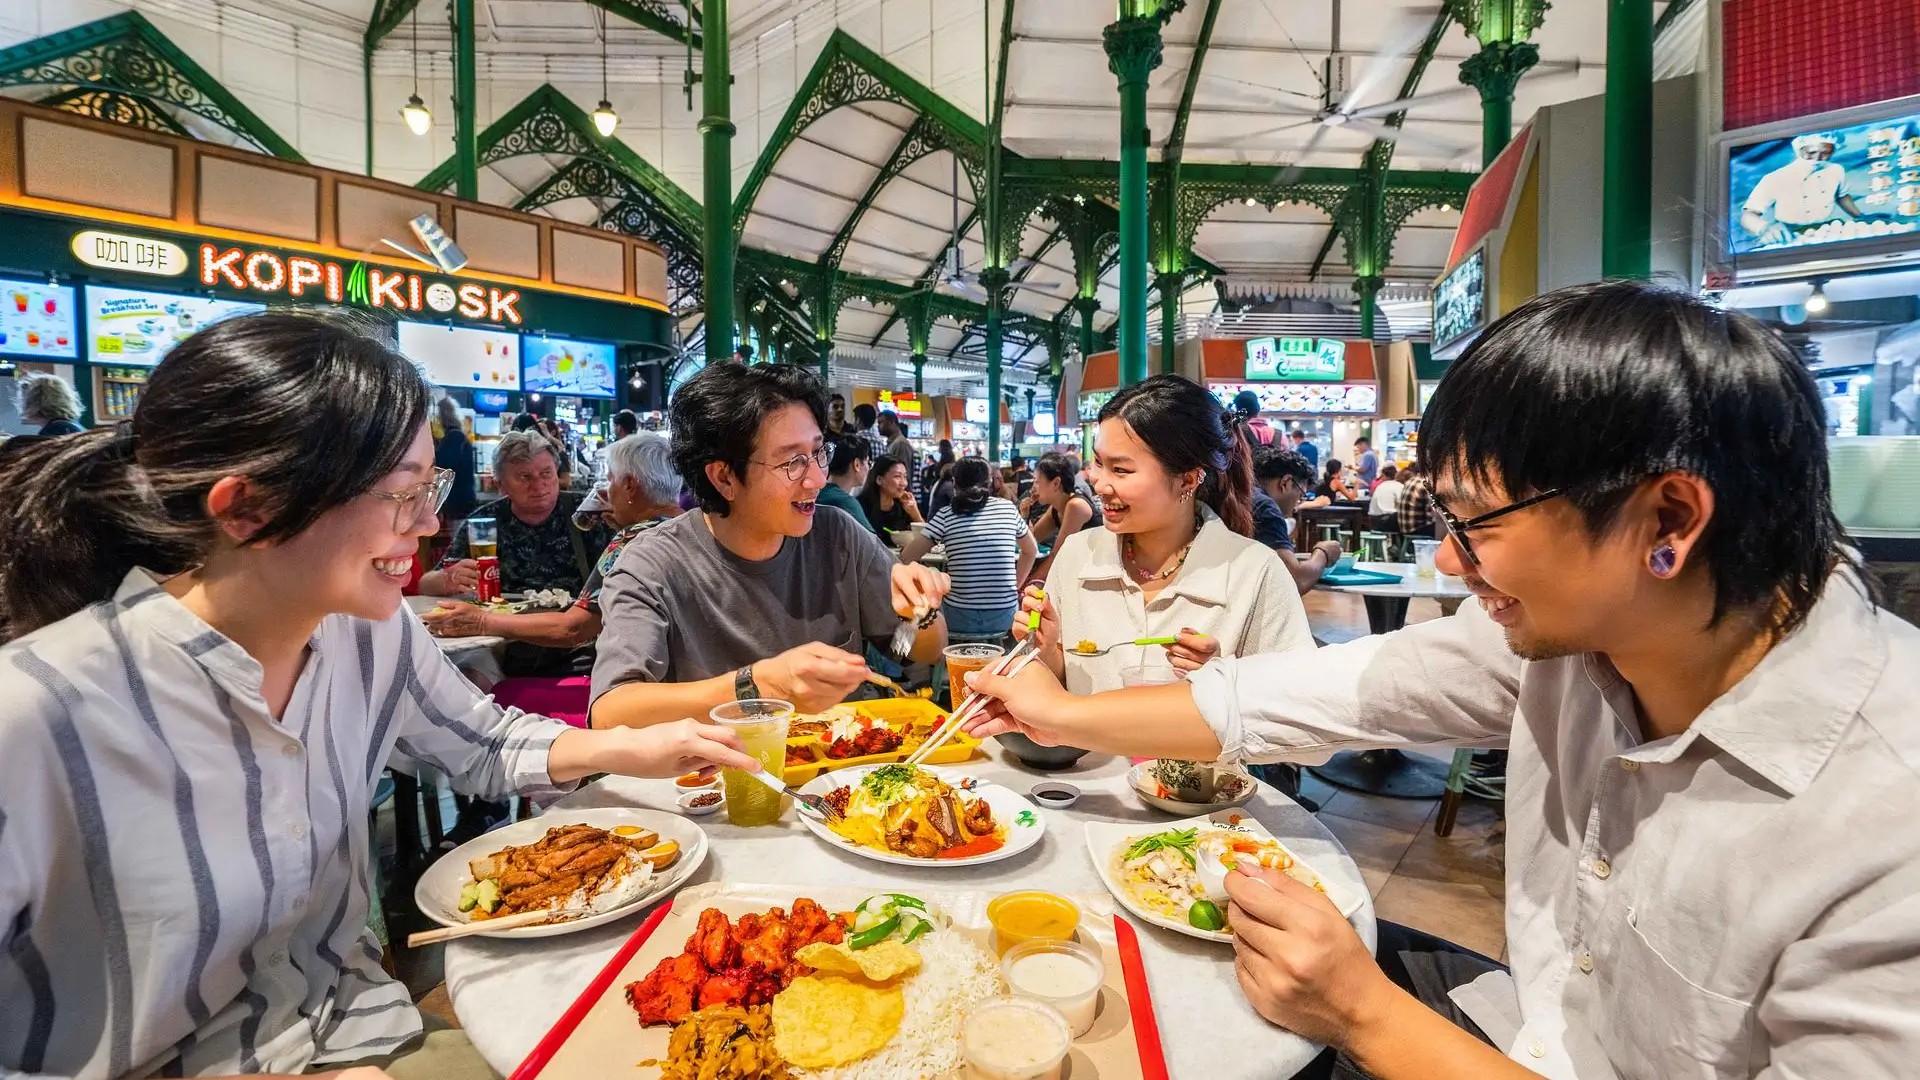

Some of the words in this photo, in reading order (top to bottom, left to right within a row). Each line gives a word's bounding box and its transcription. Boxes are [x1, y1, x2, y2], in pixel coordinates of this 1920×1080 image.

[96, 237, 167, 268] 咖啡
[200, 243, 342, 302] KOPI
[369, 269, 522, 324] KIOSK
